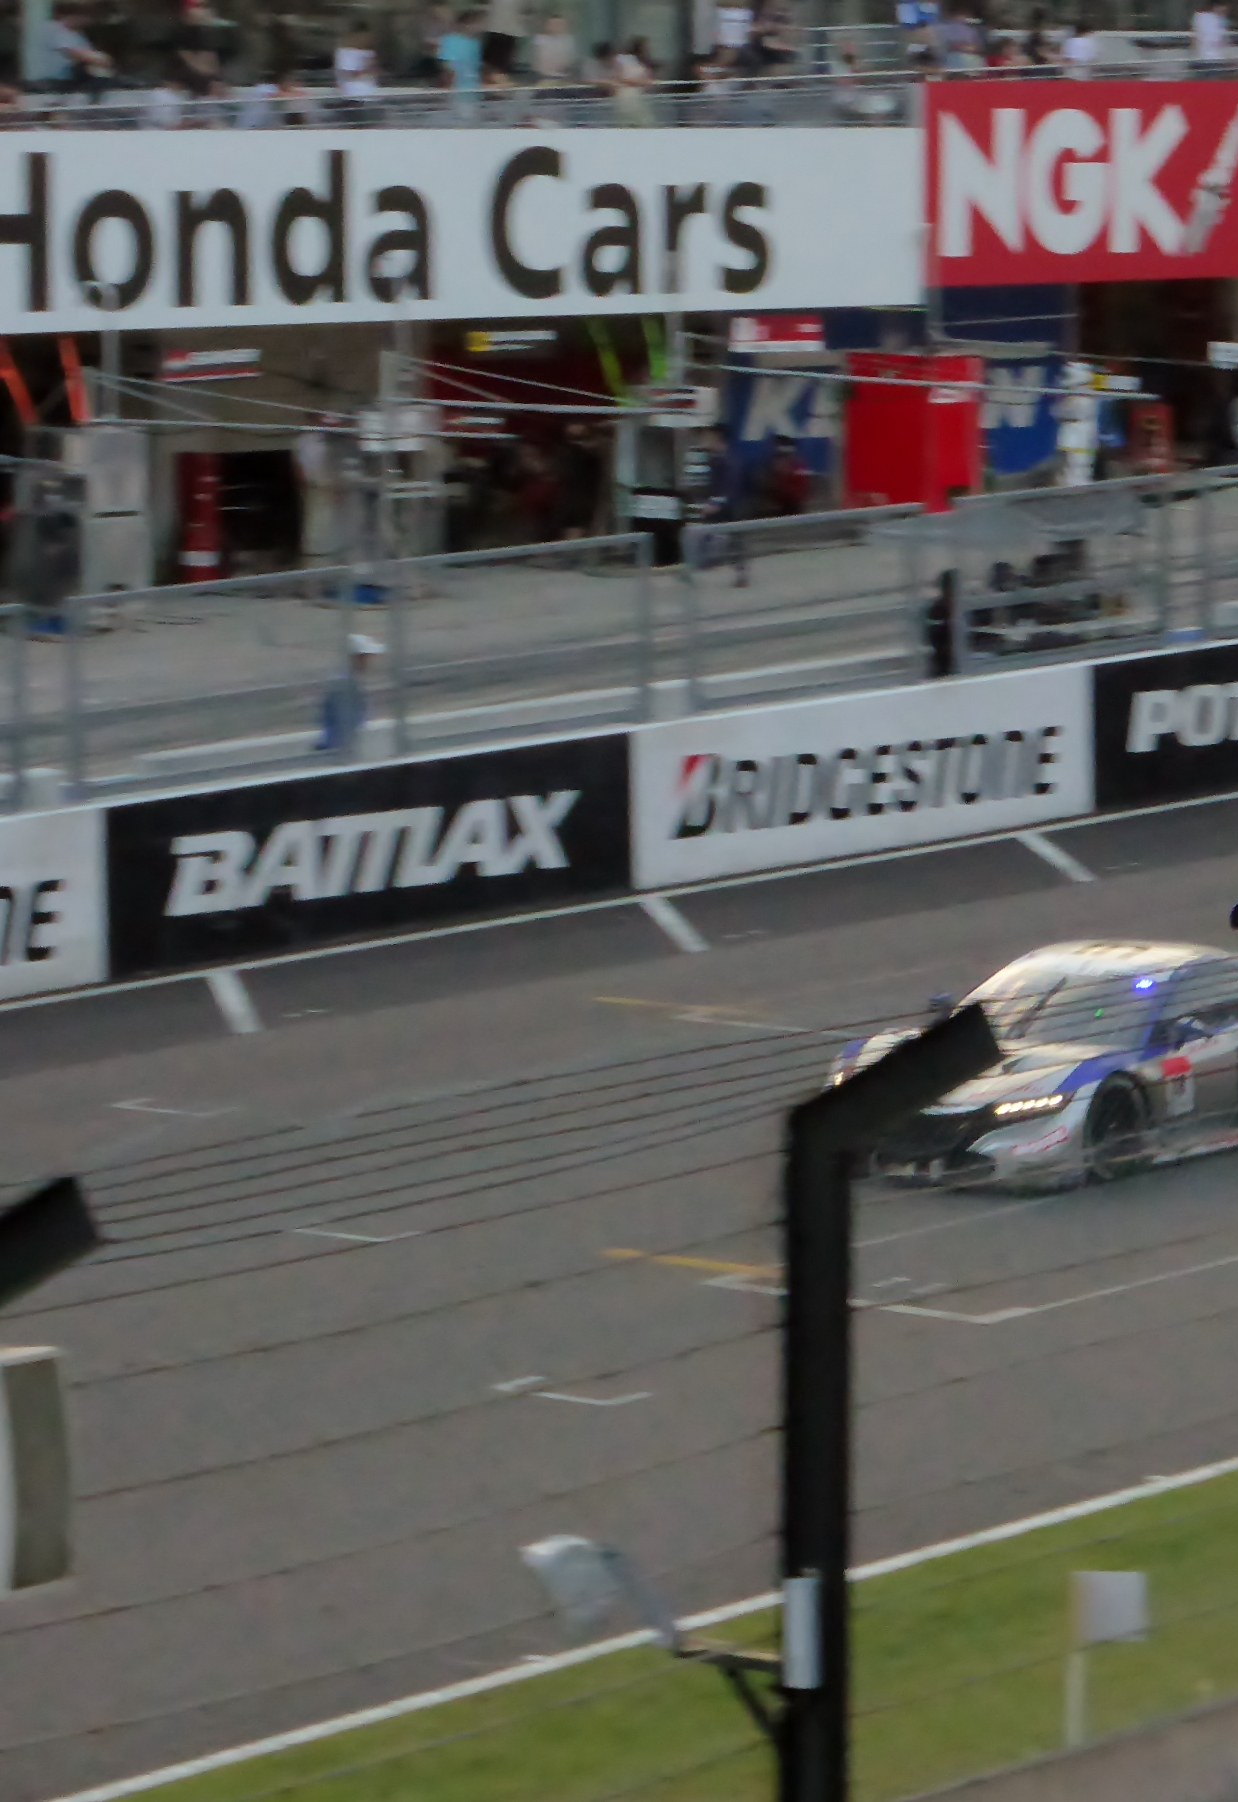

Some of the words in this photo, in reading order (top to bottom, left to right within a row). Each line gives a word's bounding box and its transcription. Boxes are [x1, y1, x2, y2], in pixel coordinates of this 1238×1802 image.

[490, 146, 767, 299] Cars
[937, 105, 1191, 257] NGK
[673, 726, 1062, 839] BRIDGESTONE
[163, 790, 582, 916] BATTLAX
